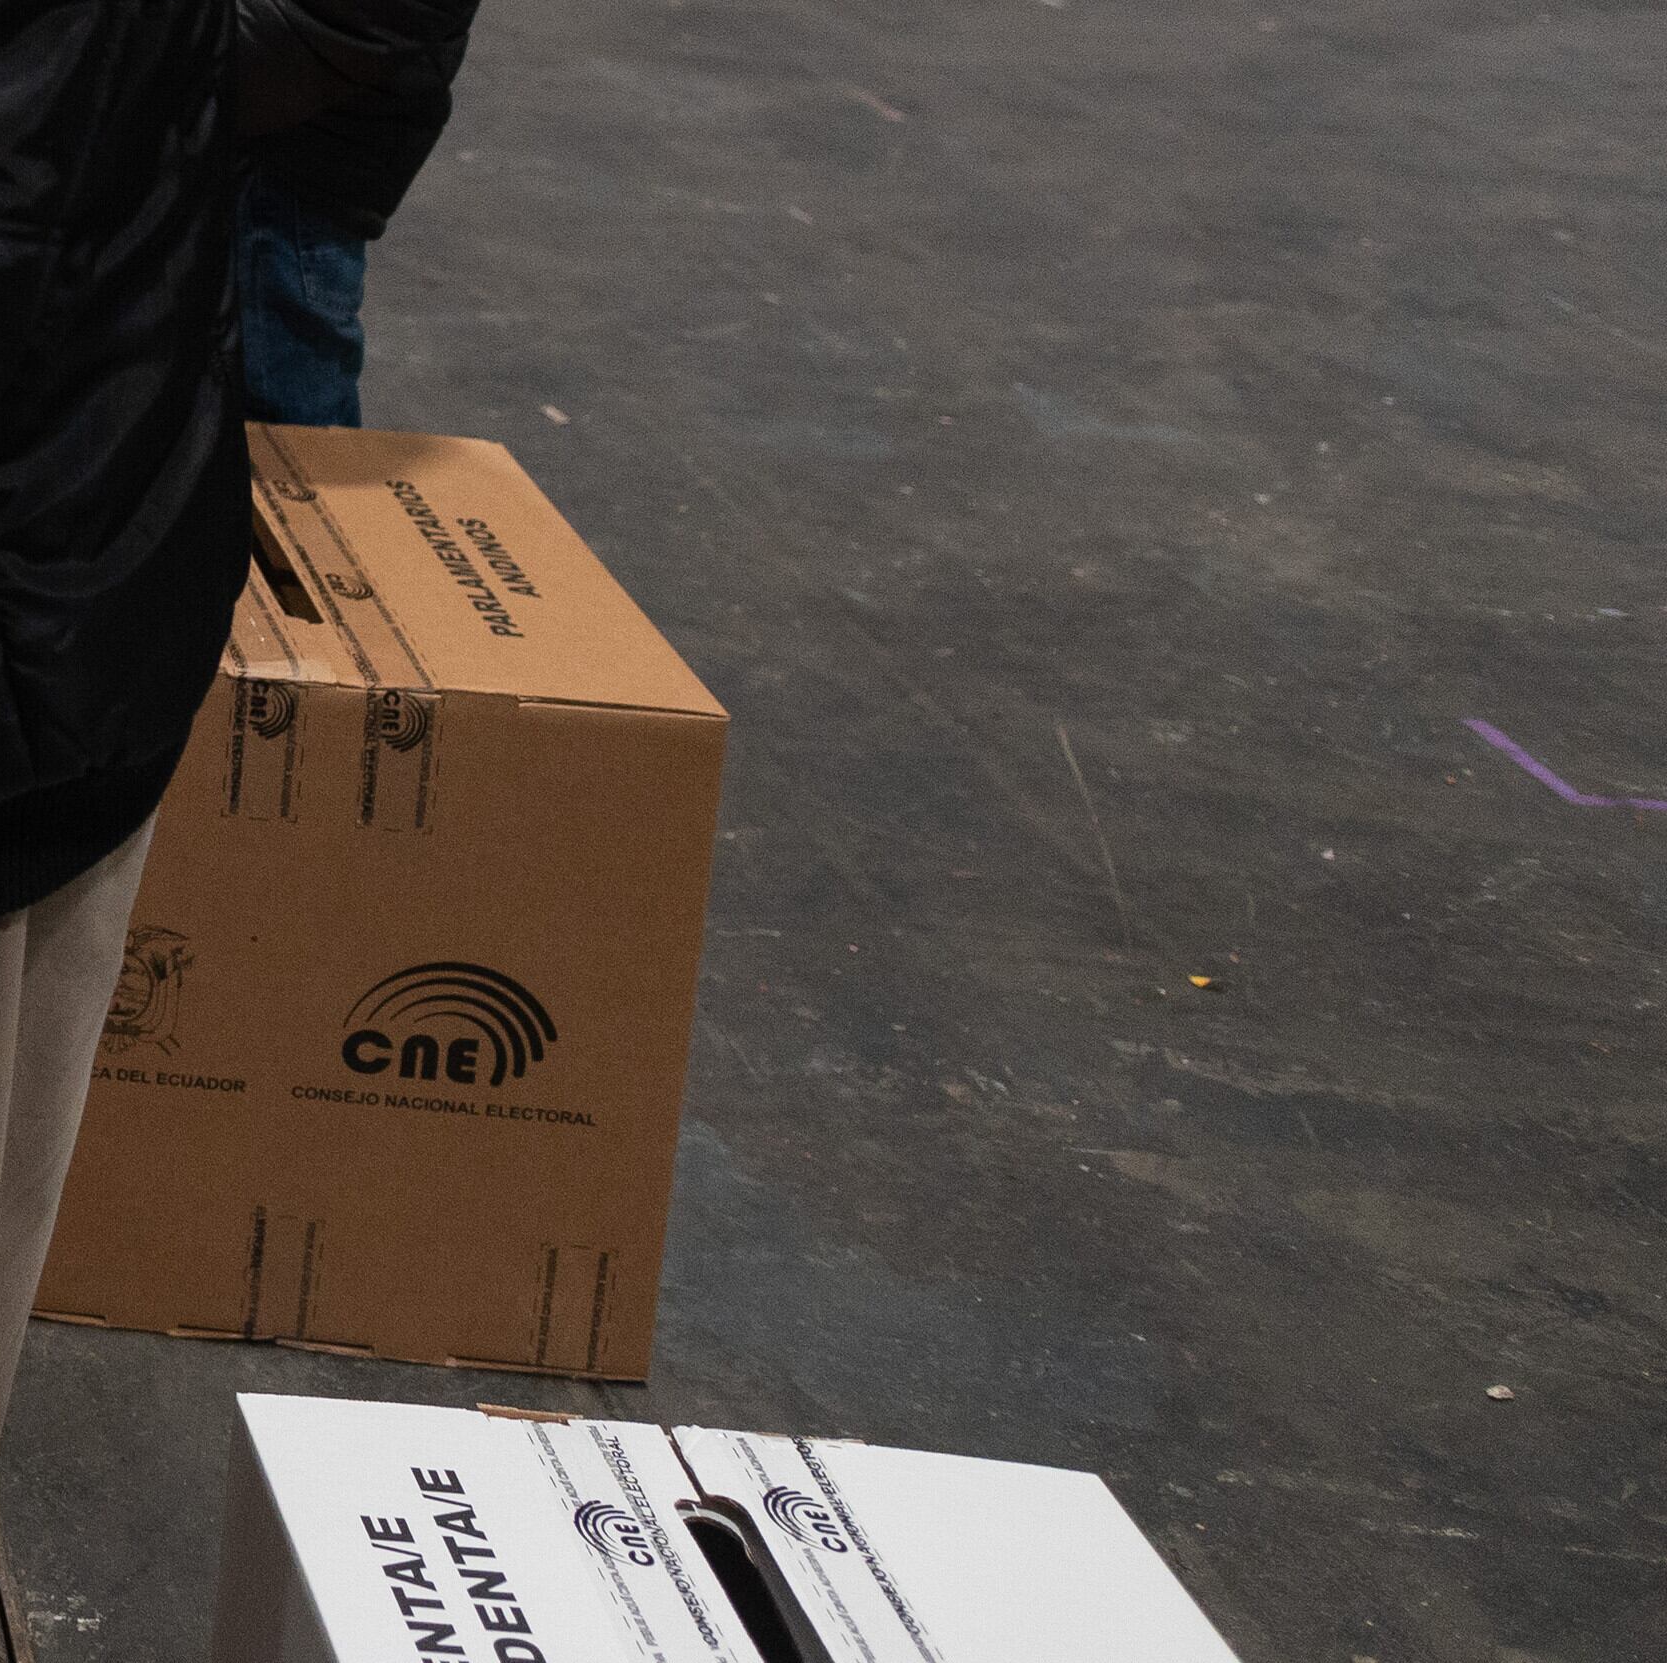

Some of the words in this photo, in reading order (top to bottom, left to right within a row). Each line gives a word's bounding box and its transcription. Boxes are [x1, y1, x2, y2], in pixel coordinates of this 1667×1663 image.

[385, 479, 524, 638] PARLAMENTARIOS
[456, 517, 542, 599] ANDINOS
[116, 1068, 151, 1084] DEL
[156, 1072, 246, 1093] ECUADOR
[291, 1085, 380, 1106] CONSEJO
[384, 1094, 481, 1116] NACIONAL
[485, 1104, 597, 1127] ELECTORAL
[610, 1435, 650, 1508] ELECTORAL
[360, 1515, 469, 1663] NTA/E
